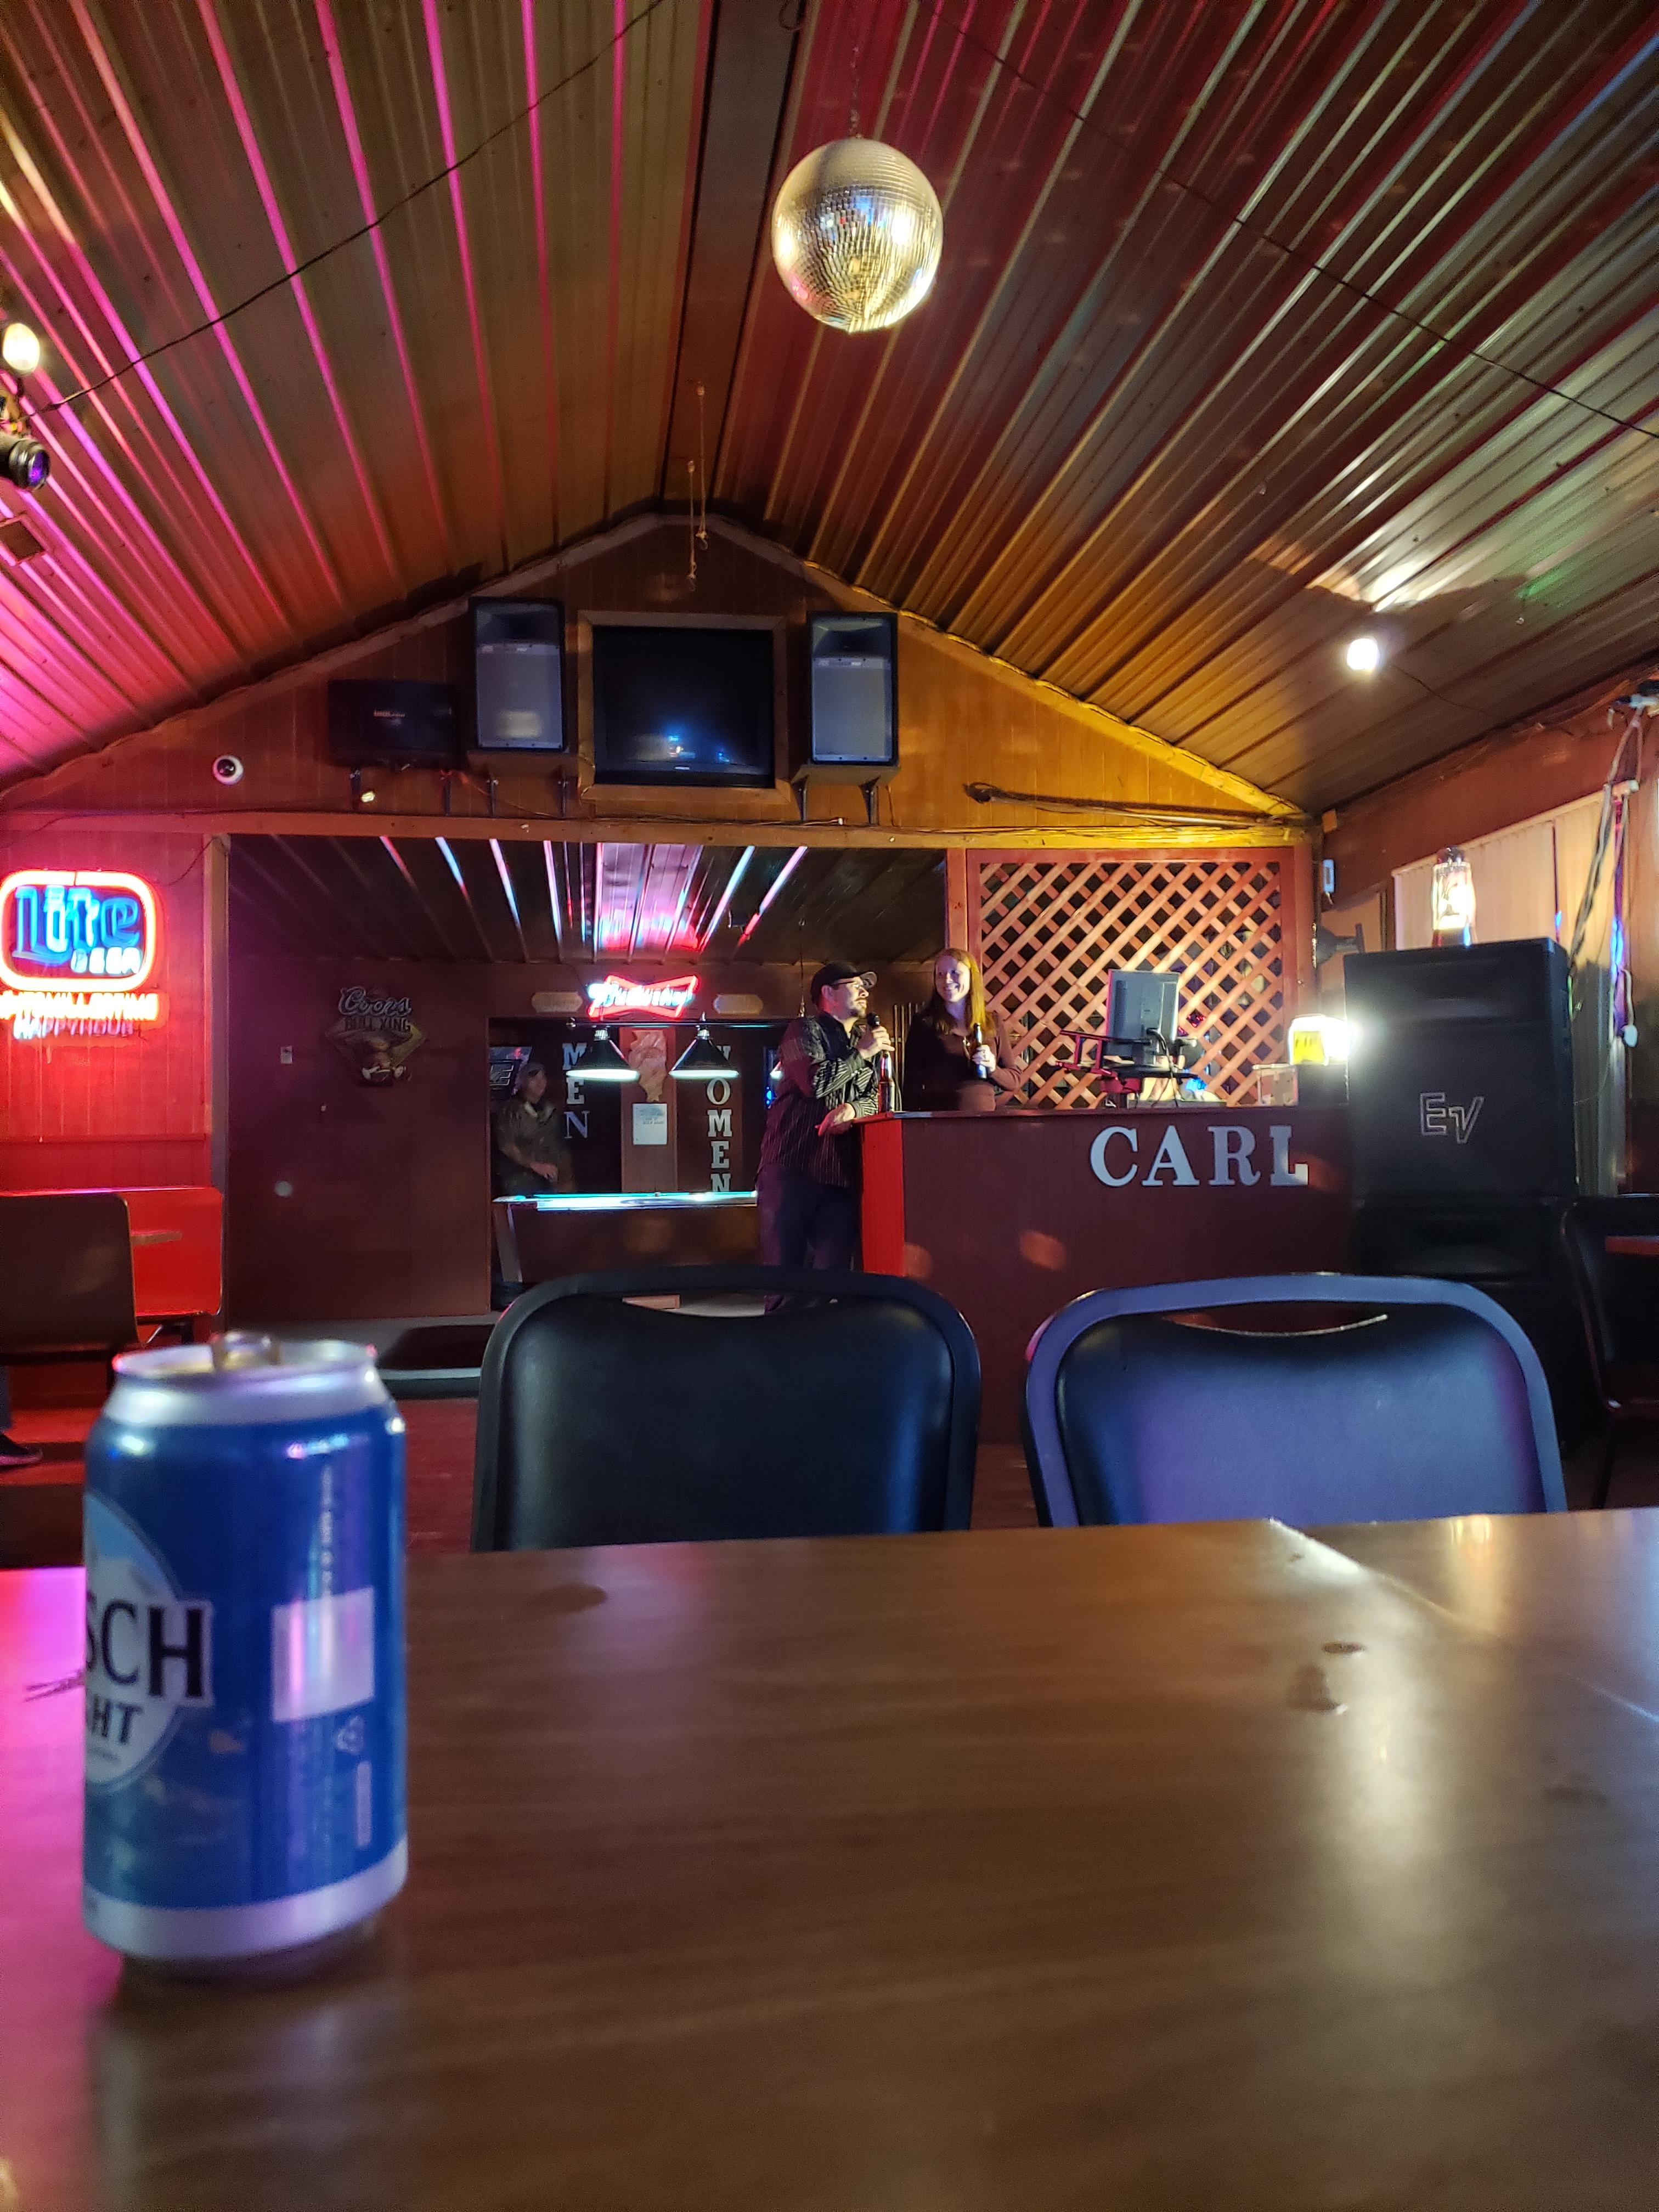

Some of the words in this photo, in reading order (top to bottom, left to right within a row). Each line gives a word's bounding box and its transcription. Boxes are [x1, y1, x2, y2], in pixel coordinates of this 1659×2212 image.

[338, 986, 412, 1015] Coors
[707, 1045, 733, 1192] OMEN
[1090, 1125, 1309, 1187] CARL
